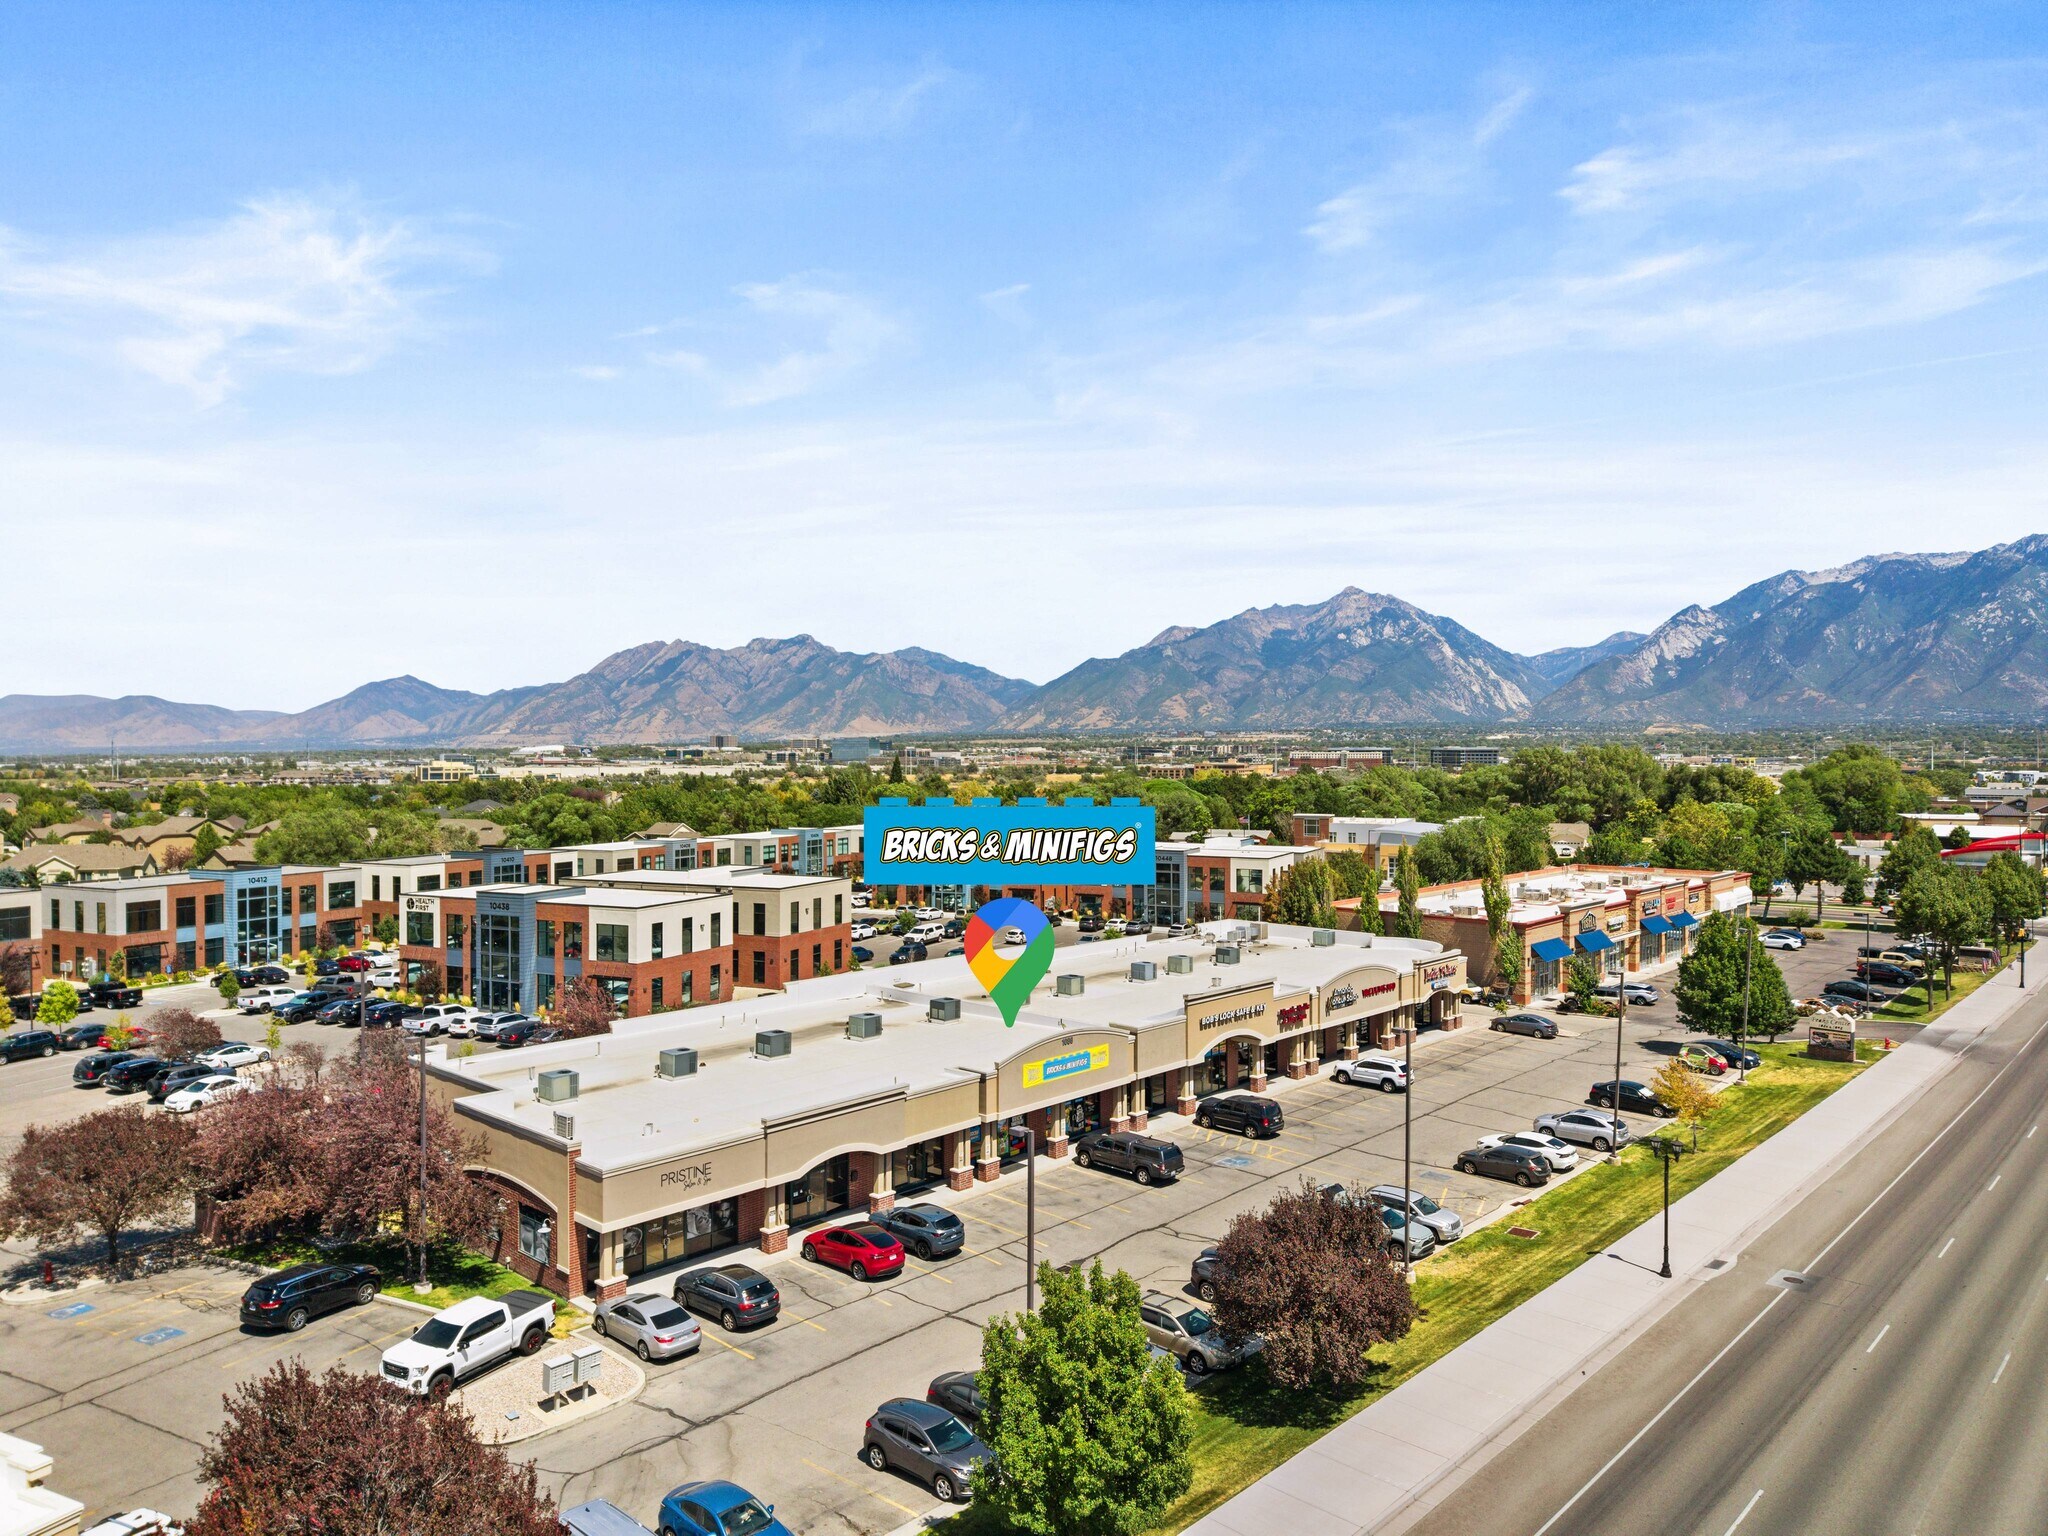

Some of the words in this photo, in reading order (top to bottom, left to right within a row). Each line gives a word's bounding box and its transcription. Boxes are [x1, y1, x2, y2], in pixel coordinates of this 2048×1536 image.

[248, 876, 268, 884] 10412
[489, 902, 510, 911] 10438
[1201, 1014, 1219, 1025] BOB'S
[1219, 1010, 1235, 1021] LOCK
[1235, 1006, 1250, 1017] SAFE
[1256, 1002, 1267, 1012] KEY
[1046, 1064, 1062, 1075] BRICKS
[660, 1161, 712, 1188] PRISTINE
